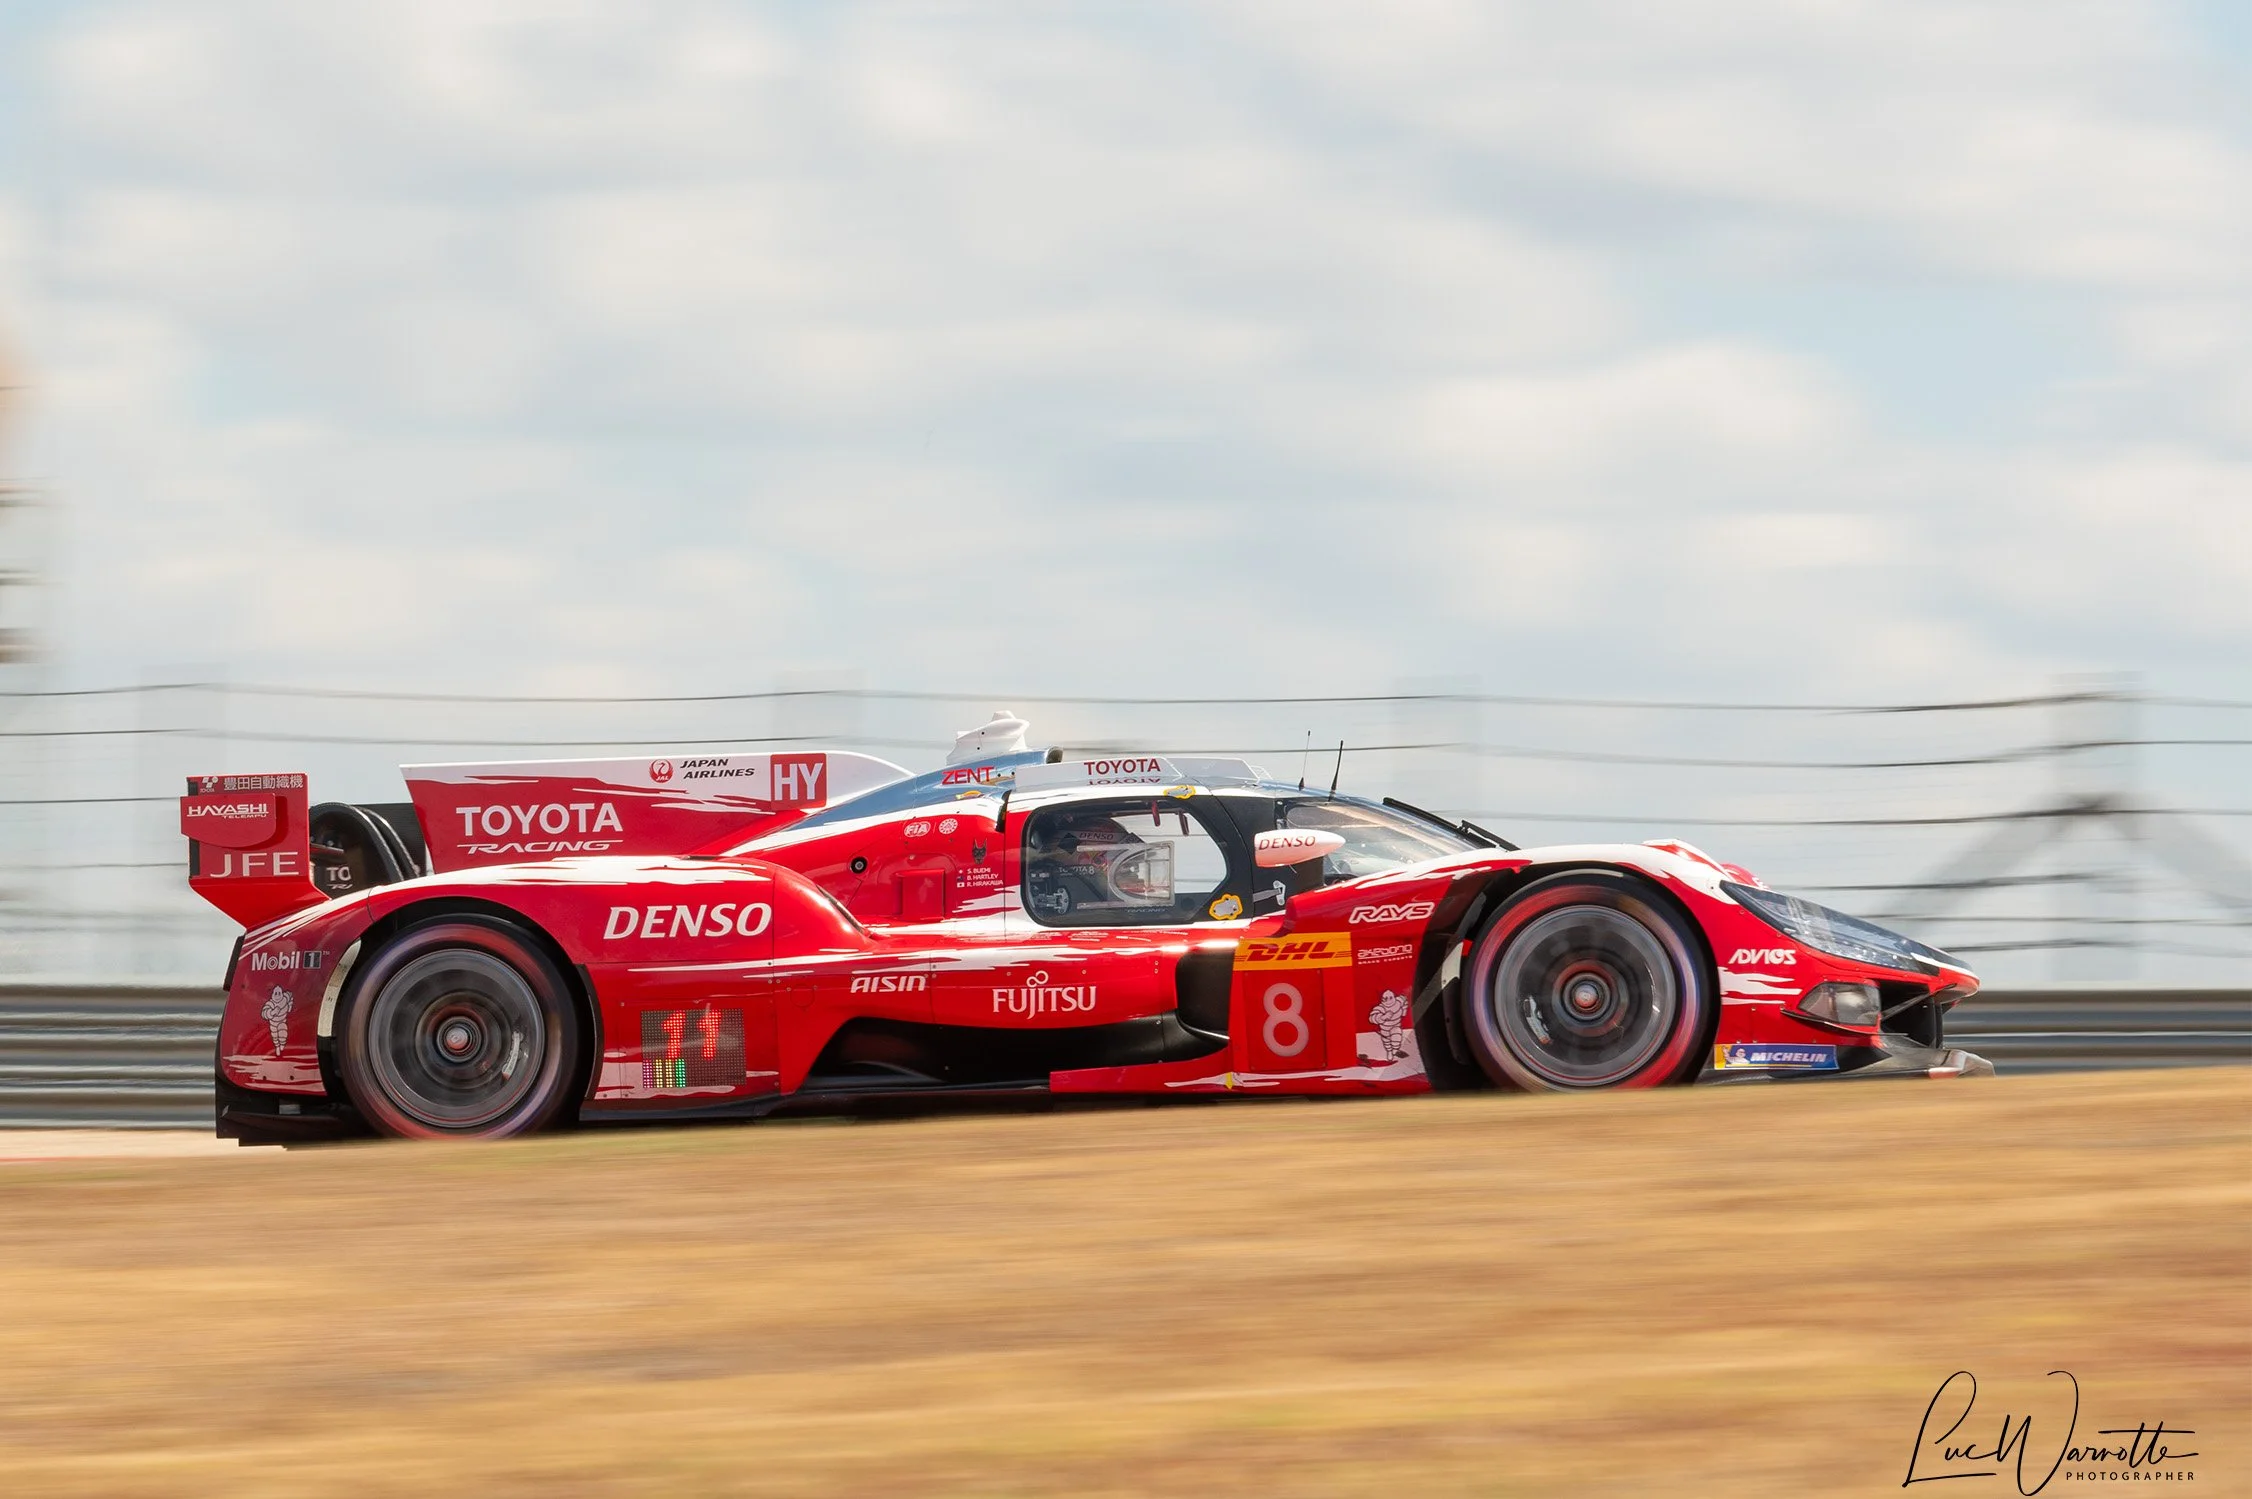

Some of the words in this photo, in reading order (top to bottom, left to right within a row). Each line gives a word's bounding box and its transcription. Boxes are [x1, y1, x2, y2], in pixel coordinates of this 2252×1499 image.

[680, 758, 729, 769] JAPAN
[1084, 758, 1161, 776] TOYOTA
[683, 768, 755, 779] AIRLINES
[774, 763, 823, 800] HY
[942, 766, 994, 785] ZENT
[187, 803, 269, 817] HAYASHI
[456, 802, 623, 836] TOYOTA
[905, 822, 929, 835] FIA
[1079, 832, 1114, 841] DENSO
[456, 840, 623, 854] RACING
[1259, 835, 1316, 850] DENSO
[210, 852, 299, 878] JFE
[603, 902, 772, 940] DENSO
[1349, 902, 1435, 924] RAYS
[1247, 941, 1335, 962] DHL
[1728, 948, 1797, 965] ADVICS
[251, 951, 300, 971] Mobil
[851, 975, 926, 993] AISIN
[992, 984, 1097, 1019] FUJITSU
[1262, 982, 1310, 1057] 8
[1750, 1052, 1827, 1062] MICHELIN
